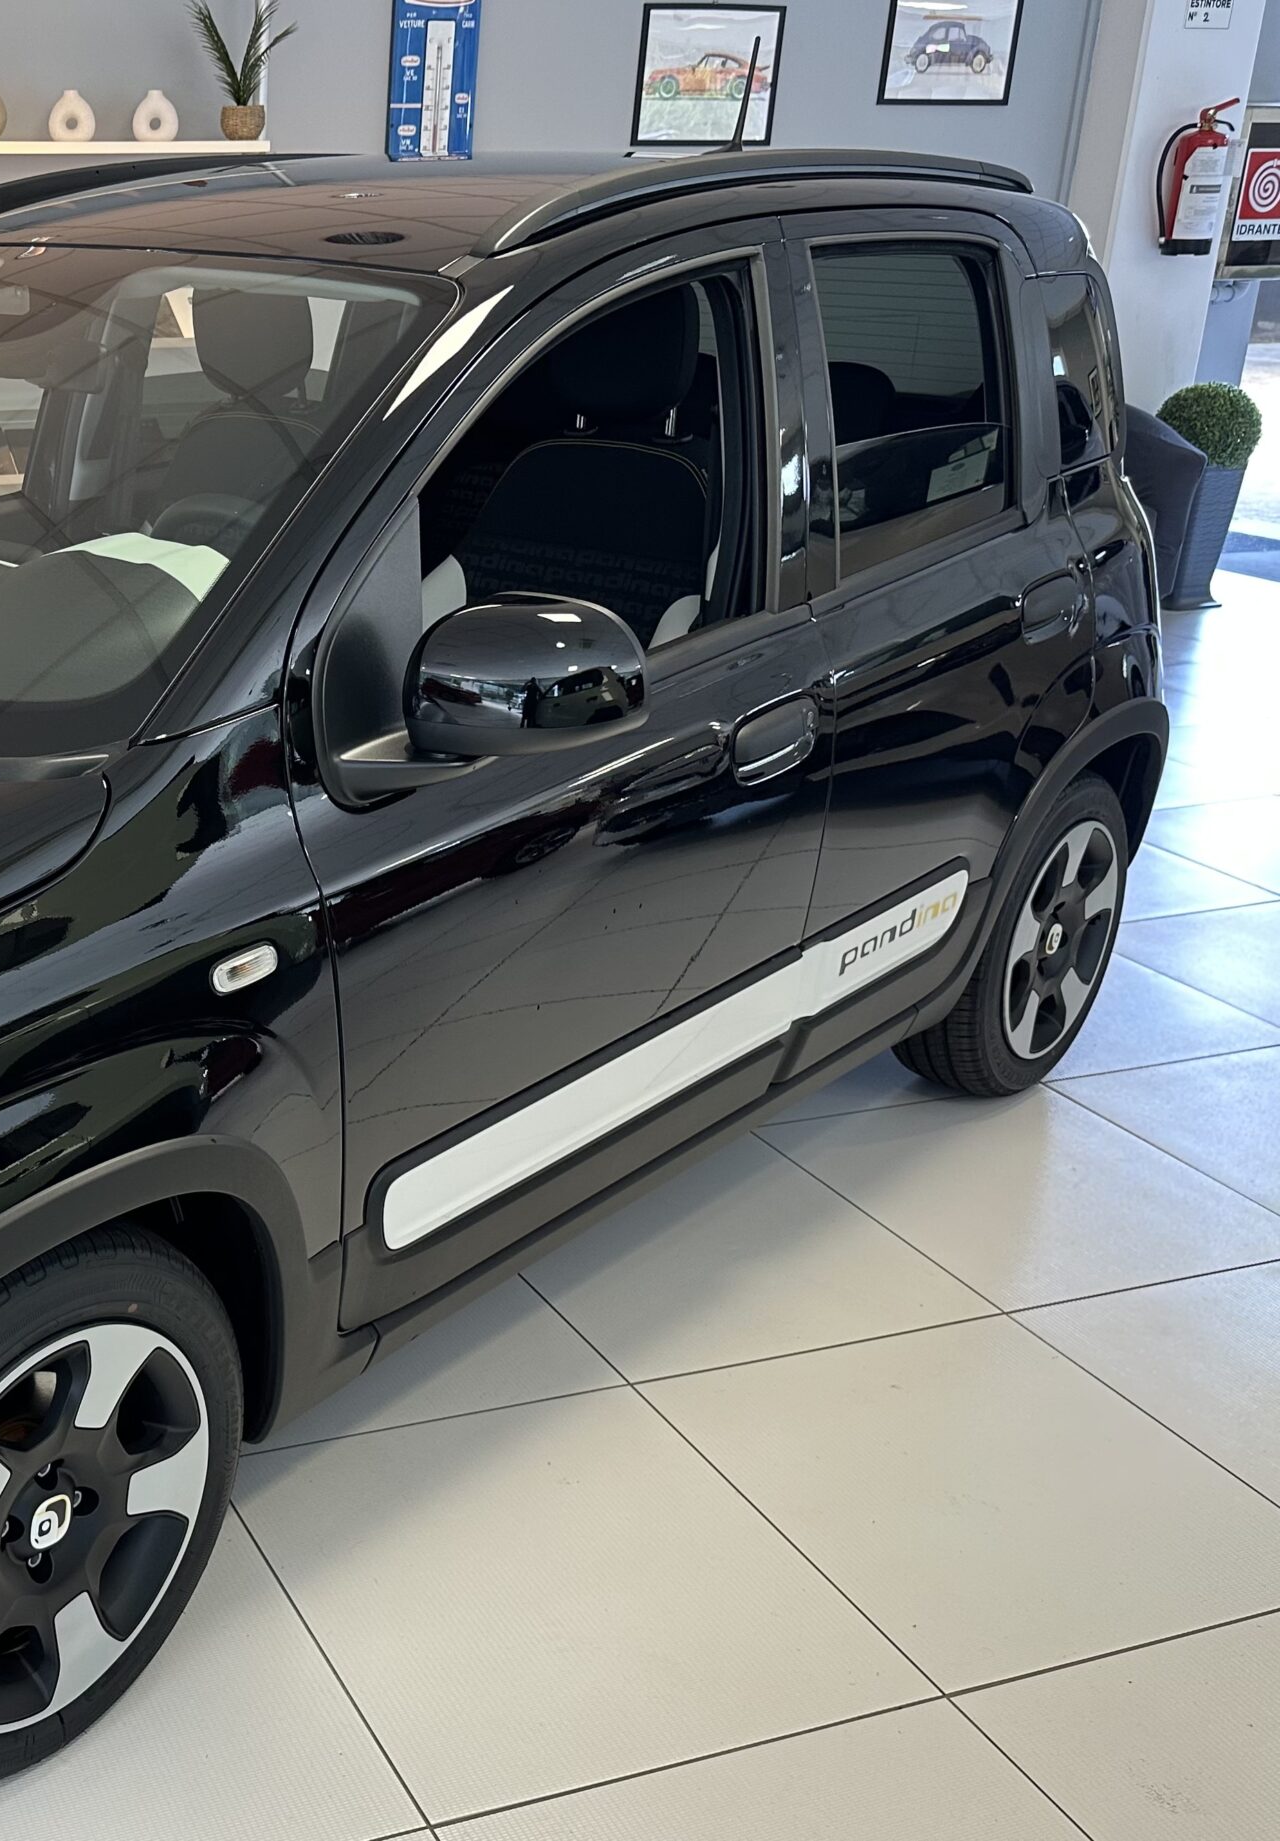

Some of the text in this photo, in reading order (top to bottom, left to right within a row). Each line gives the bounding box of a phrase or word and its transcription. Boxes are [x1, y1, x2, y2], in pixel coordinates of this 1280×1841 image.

[1190, 0, 1231, 8] ESTINTORE
[1202, 12, 1210, 22] 2
[399, 20, 425, 28] VETTURE
[839, 891, 958, 977] pandina
